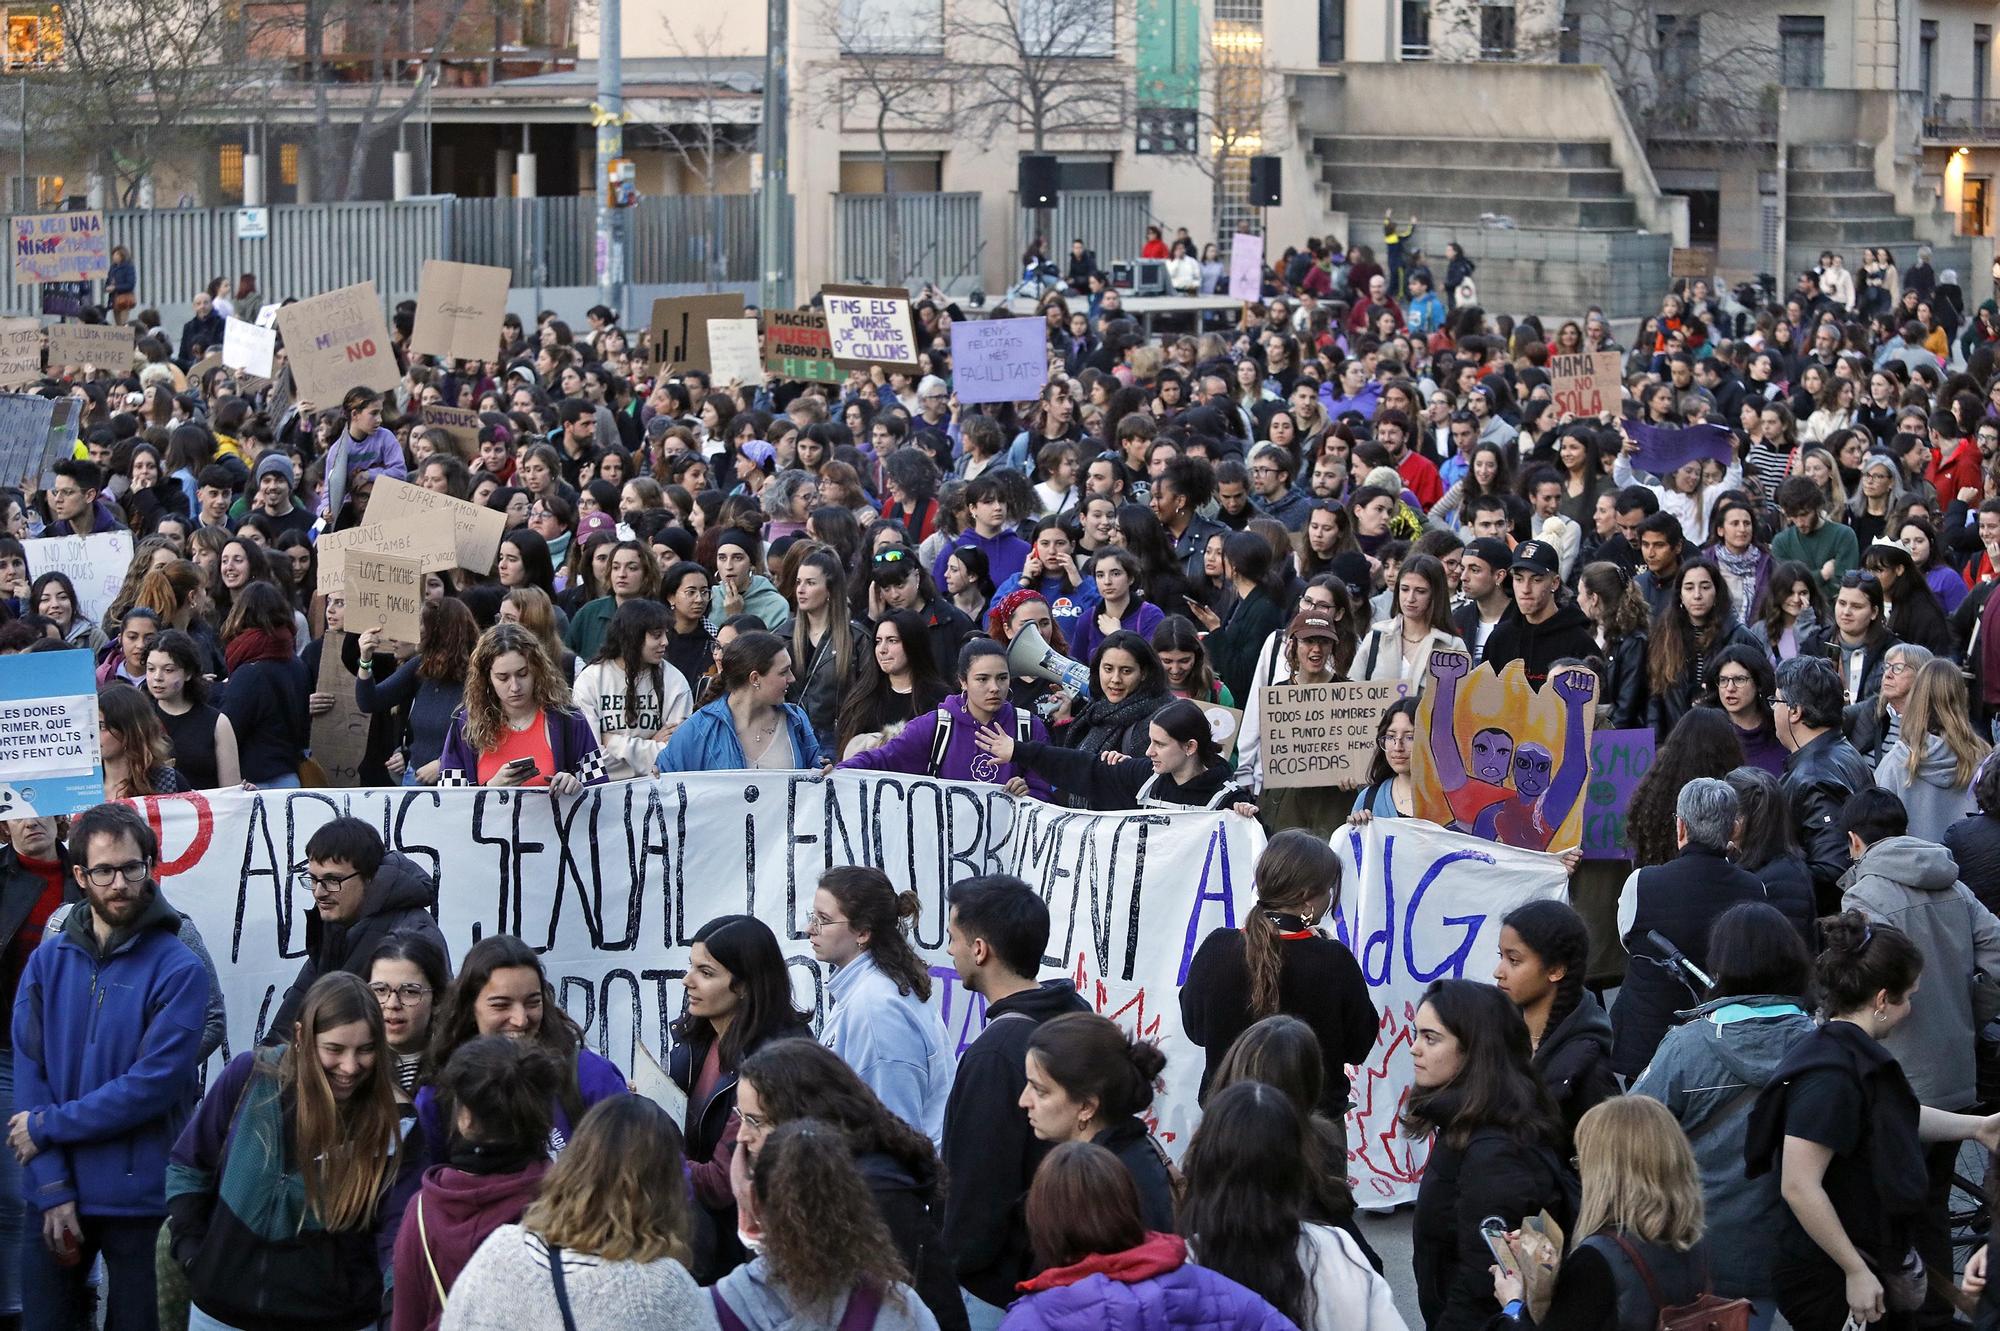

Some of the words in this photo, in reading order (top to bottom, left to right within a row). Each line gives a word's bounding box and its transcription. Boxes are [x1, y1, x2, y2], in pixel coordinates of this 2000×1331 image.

[70, 214, 100, 232] UNA
[17, 238, 56, 256] NIÑA
[870, 300, 897, 315] ELS
[851, 315, 892, 330] OVARIS
[8, 329, 40, 344] TOTES
[839, 328, 855, 341] DE
[345, 338, 377, 363] NO
[775, 343, 818, 357] ABONO
[852, 343, 909, 360] COLLONS
[967, 337, 1023, 350] FELICITATS
[74, 350, 125, 363] SEMPRE
[960, 361, 1040, 382] FACILITATS
[1552, 354, 1595, 379] MAMA
[1574, 376, 1592, 391] NO
[1554, 389, 1603, 418] SOLA
[398, 485, 438, 509] SUFRE
[323, 532, 343, 552] LES
[375, 535, 411, 553] TAMBÉ
[43, 543, 60, 562] NO
[67, 540, 89, 562] SOM
[359, 560, 385, 583] LOVE
[359, 591, 381, 609] HATE
[387, 594, 415, 615] MACHIS
[600, 694, 658, 711] REEL
[1267, 690, 1283, 705] EL
[1288, 687, 1327, 703] PUNTO
[1331, 686, 1347, 701] NO
[1349, 686, 1362, 701] ES
[1367, 686, 1389, 700] QUE
[24, 705, 66, 719] DONES
[1267, 709, 1302, 723] TODOS
[1305, 709, 1325, 722] LOS
[1330, 707, 1376, 720] HOMBRES
[46, 718, 72, 730] QUE
[1270, 729, 1285, 740] EL
[1291, 727, 1326, 739] PUNTO
[1329, 725, 1343, 736] ES
[1347, 725, 1369, 737] QUE
[40, 731, 81, 744] MOLTS
[23, 747, 54, 760] FENT
[57, 744, 83, 757] CUA
[1270, 744, 1288, 755] LAS
[1293, 742, 1340, 754] MUJERES
[1347, 740, 1375, 751] HEMOS
[1269, 754, 1351, 775] ACOSADAS
[471, 780, 693, 956] SEXUAL
